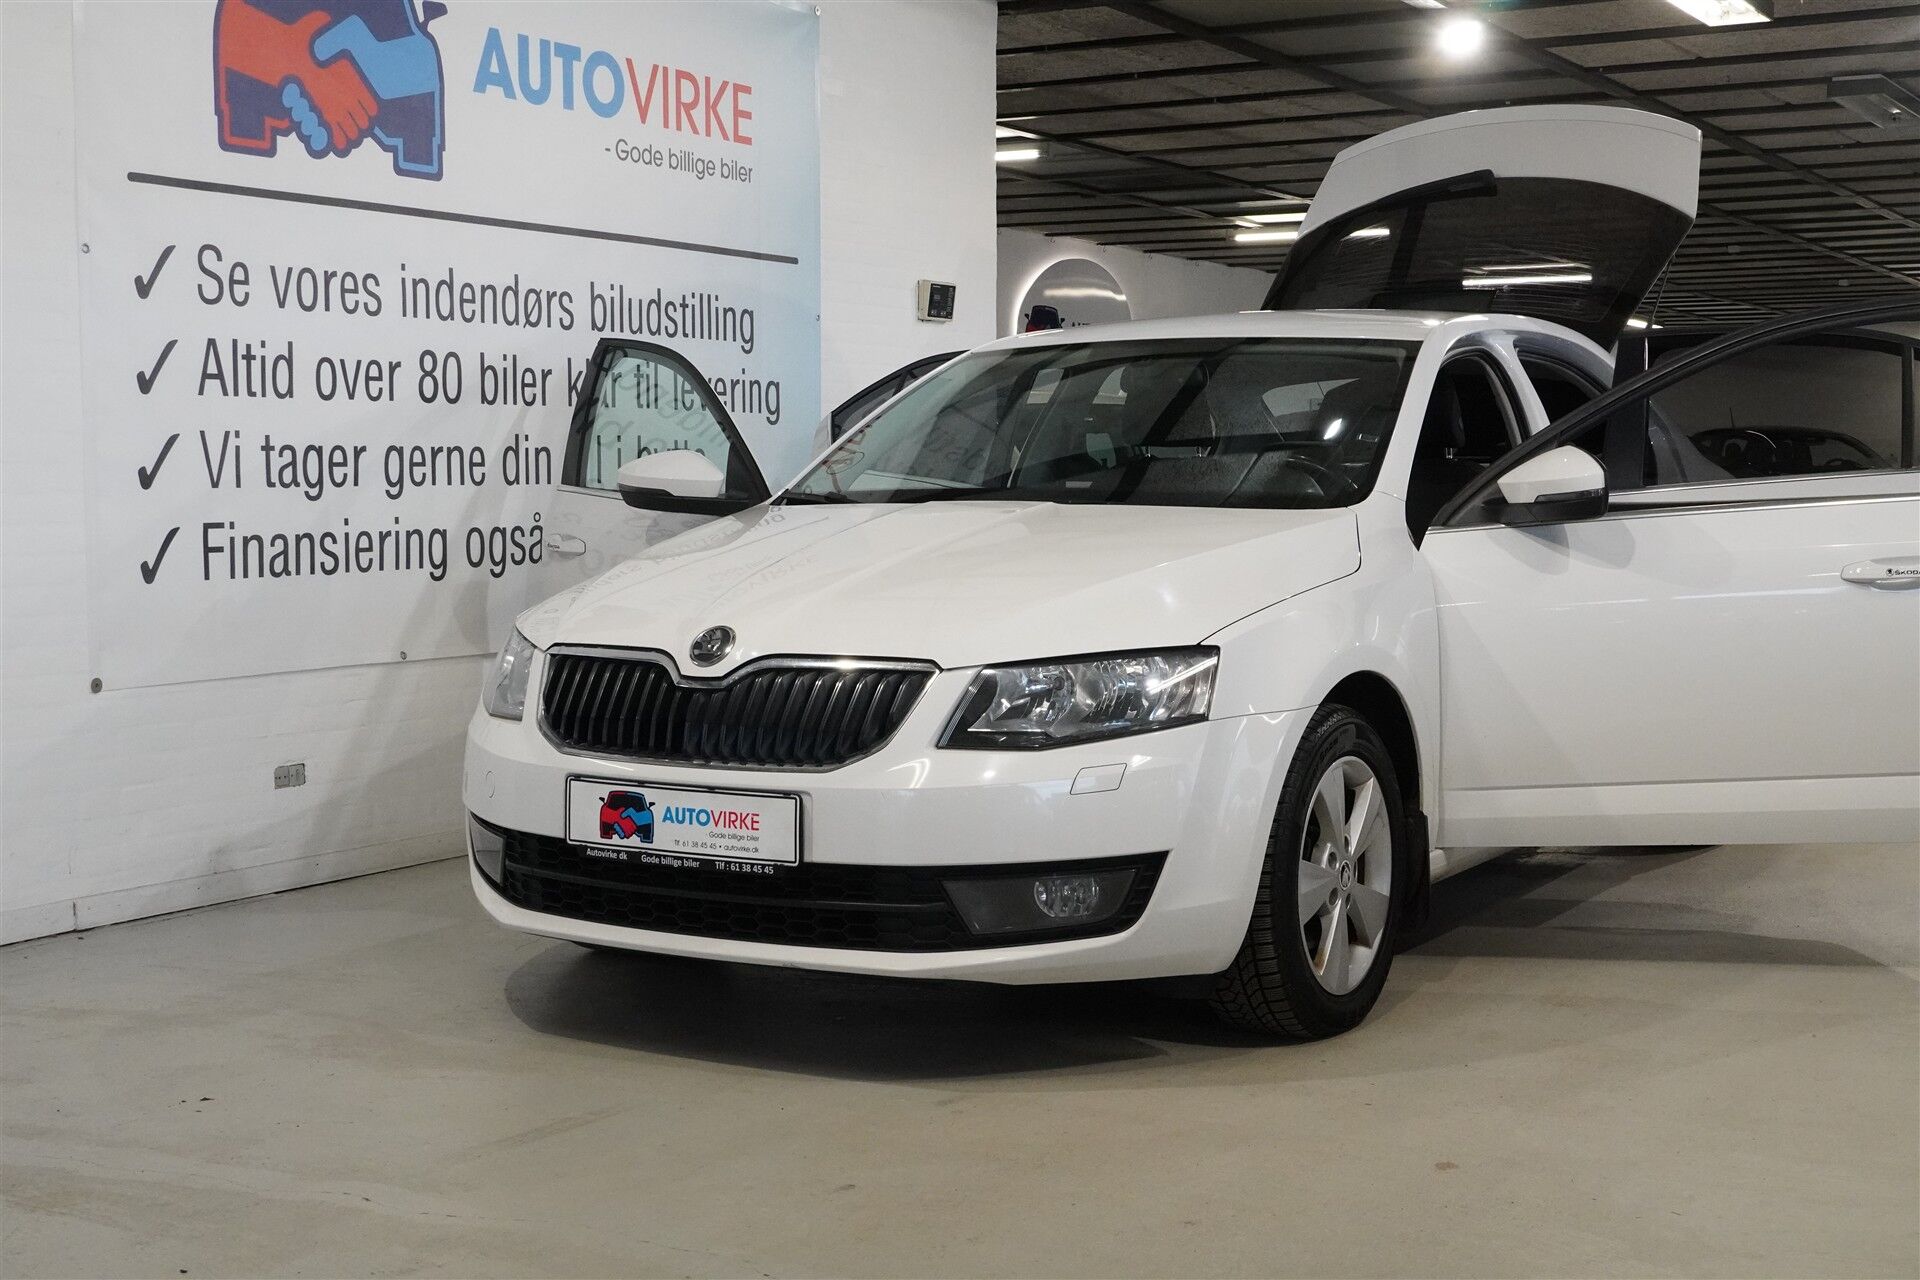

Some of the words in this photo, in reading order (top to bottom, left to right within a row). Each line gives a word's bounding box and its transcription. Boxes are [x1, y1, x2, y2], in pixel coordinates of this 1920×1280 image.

[473, 27, 753, 146] AUTOVIRKE
[615, 138, 663, 167] Gode
[667, 146, 716, 180] billige
[720, 155, 753, 184] biler
[197, 243, 250, 308] Se
[269, 264, 383, 317] vores
[400, 262, 575, 332] indendørs
[590, 280, 755, 355] biludstilling
[197, 337, 294, 400] Altid
[315, 358, 402, 403] over
[417, 349, 463, 405] 80
[479, 351, 553, 408] biler
[633, 361, 659, 410] til
[199, 430, 242, 489] Vi
[260, 434, 368, 502] tager
[383, 444, 487, 501] gerne
[502, 434, 552, 487] din
[202, 516, 448, 582] Finansiering
[465, 511, 544, 578] også
[662, 806, 760, 831] AUTOVIRKE
[586, 848, 618, 860] Autovirke
[700, 841, 708, 849] 45
[709, 842, 717, 850] 45
[708, 831, 727, 840] Gode
[727, 832, 746, 843] billige
[746, 834, 760, 842] biler
[641, 854, 660, 864] Gode
[660, 855, 683, 867] billige
[683, 858, 700, 869] biler
[730, 863, 740, 872] 61
[741, 864, 751, 872] 38
[753, 865, 763, 873] 45
[763, 866, 774, 875] 45
